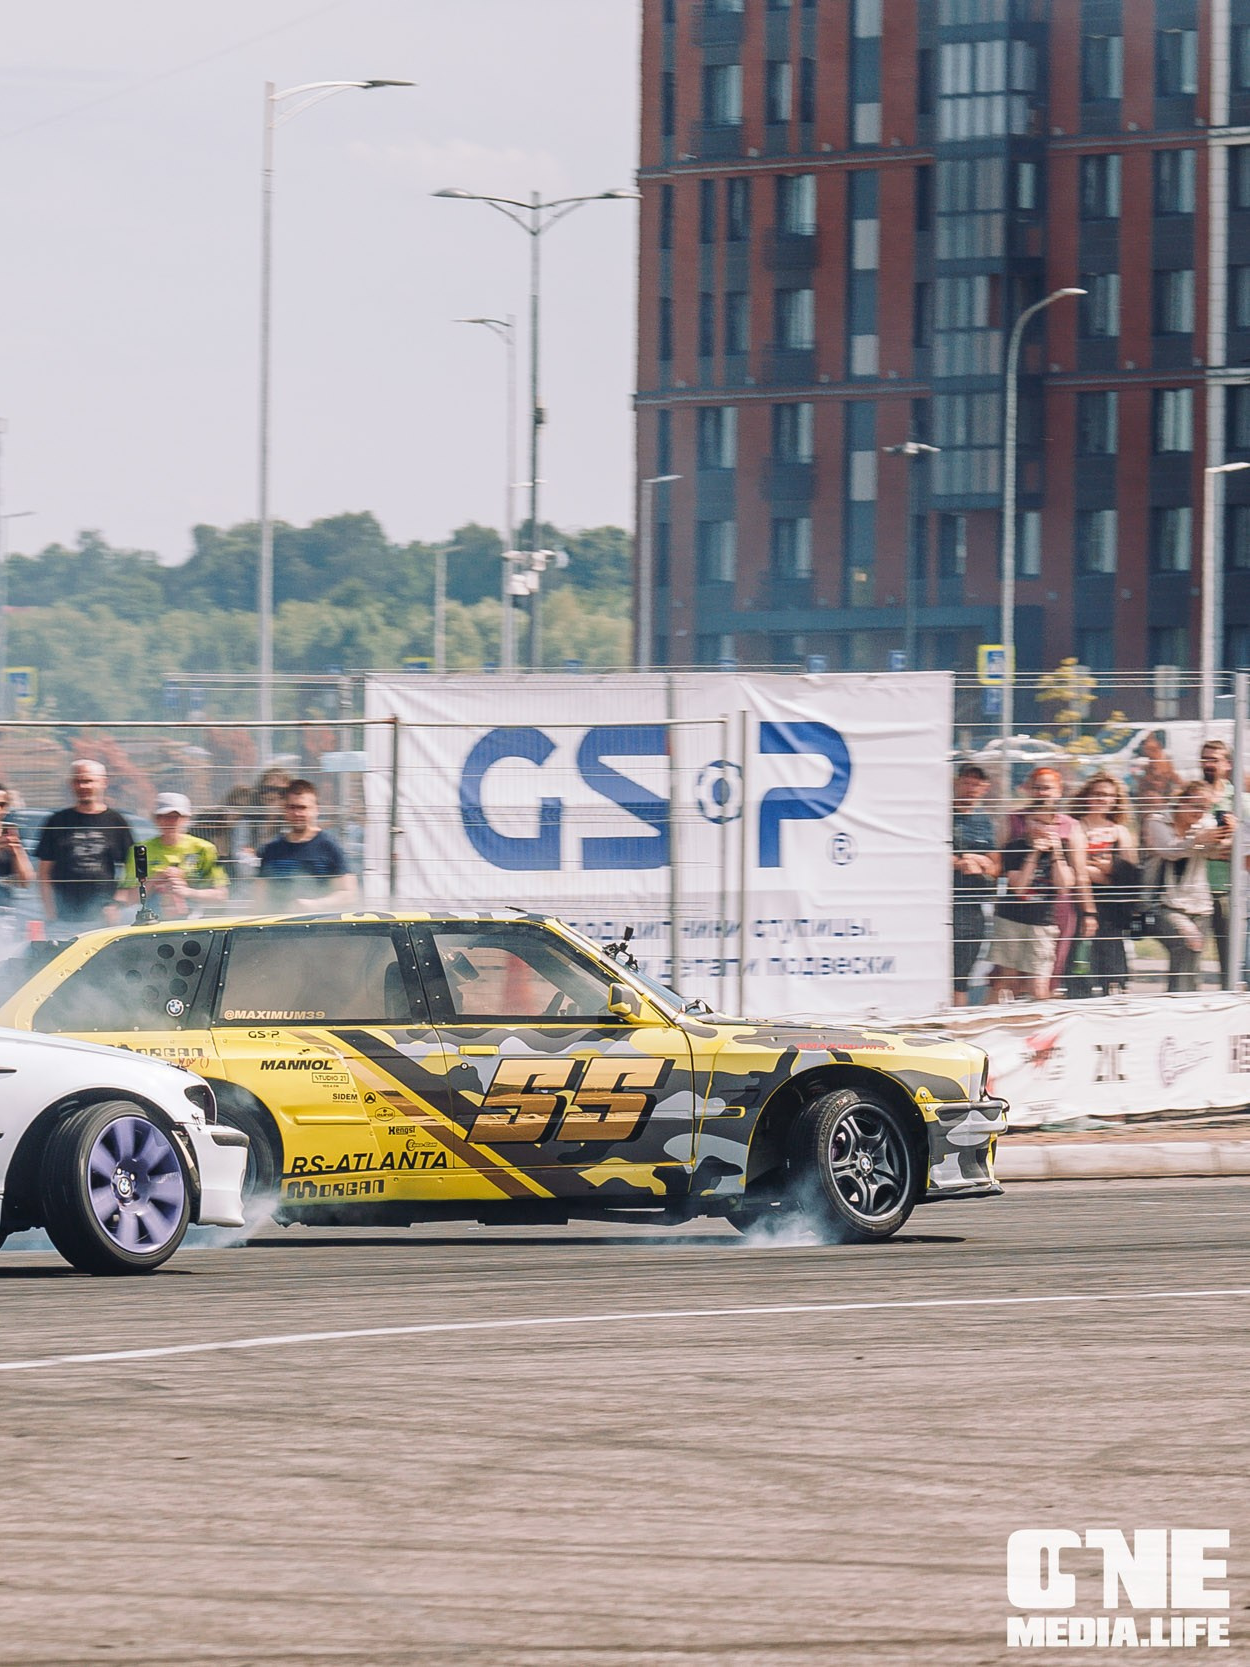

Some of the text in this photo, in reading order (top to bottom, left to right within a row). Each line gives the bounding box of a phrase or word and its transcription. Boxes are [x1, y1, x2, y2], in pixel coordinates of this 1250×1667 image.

[224, 1010, 326, 1021] @MAXIMUM39
[117, 1044, 204, 1057] ORGAN
[261, 1060, 333, 1070] MANNOL
[388, 1126, 416, 1135] Hengst
[291, 1151, 448, 1174] RS-ATLANTA
